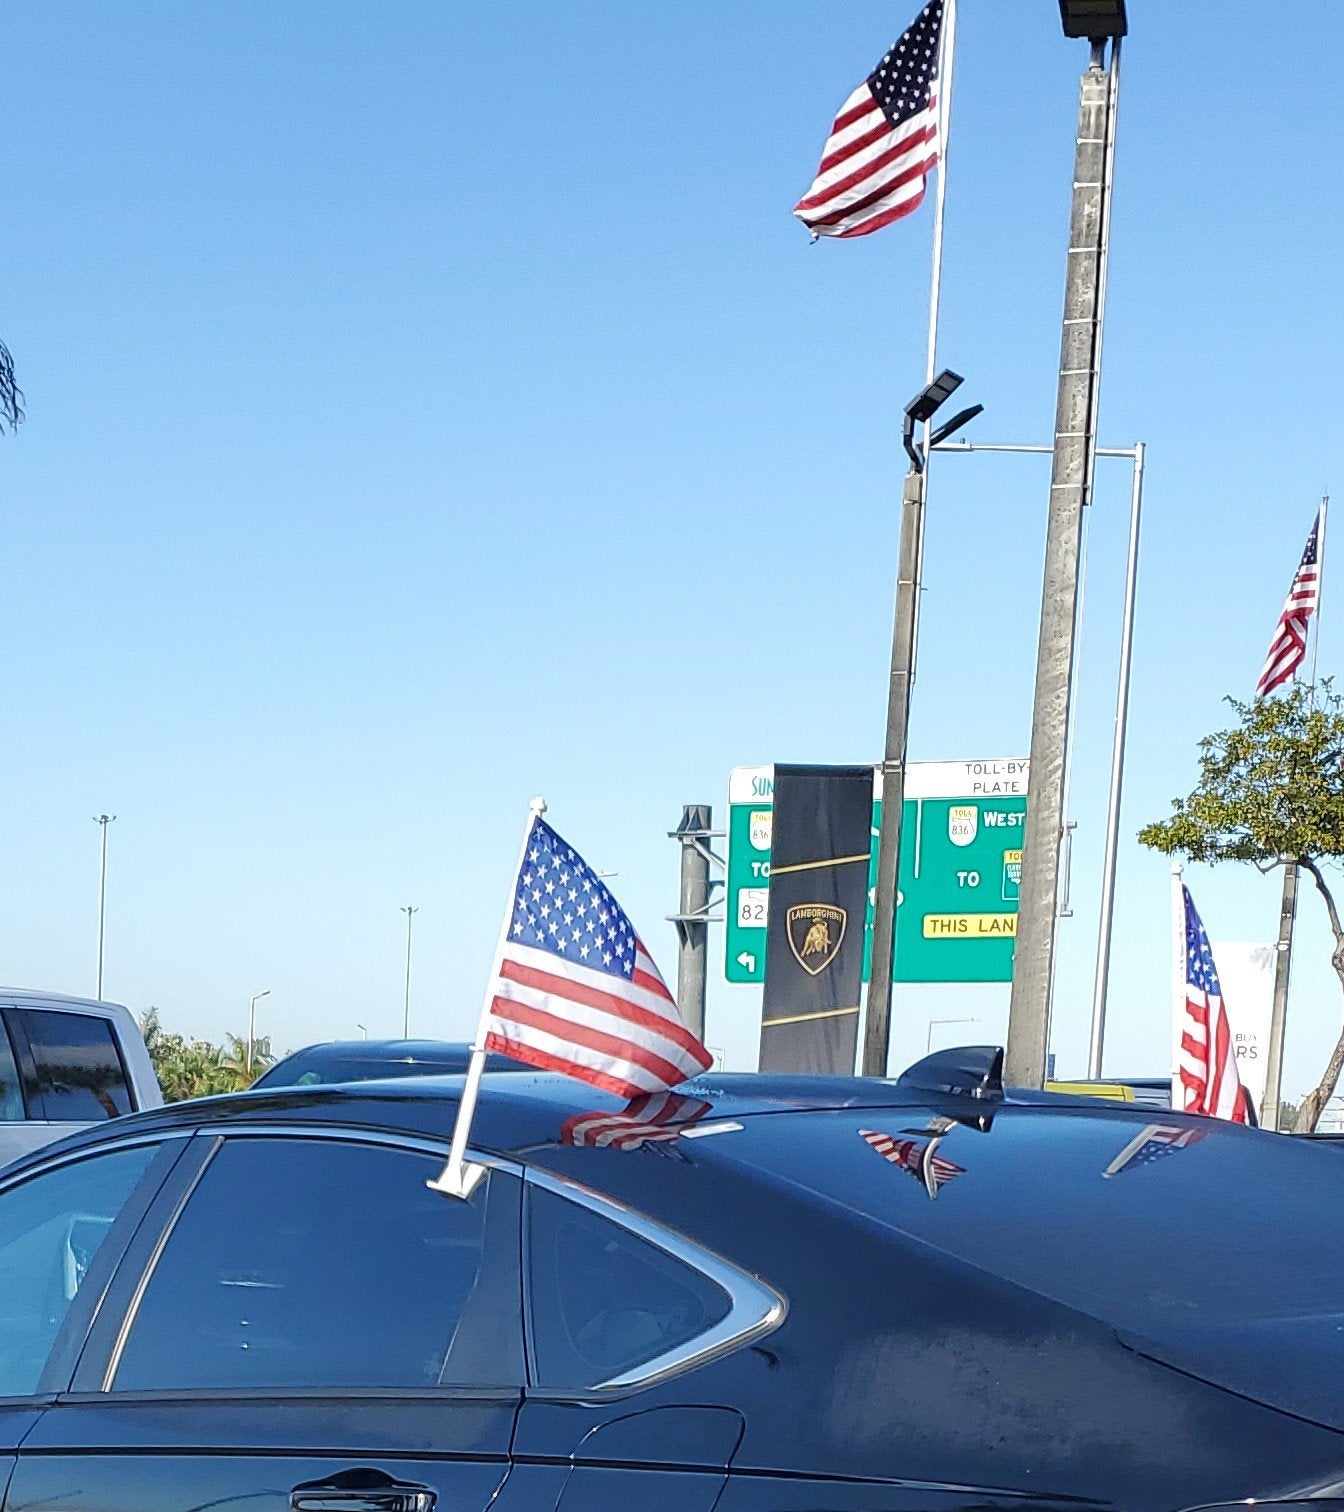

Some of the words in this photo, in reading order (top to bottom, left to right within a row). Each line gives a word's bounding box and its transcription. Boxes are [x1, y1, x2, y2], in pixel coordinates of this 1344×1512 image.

[752, 776, 774, 796] SUN
[973, 781, 1020, 793] PLATE
[955, 809, 972, 817] TOLL
[984, 811, 1026, 828] WEST
[952, 825, 969, 835] 836
[751, 862, 770, 877] TO
[957, 871, 980, 887] TO
[742, 905, 766, 920] 82
[930, 919, 968, 933] THIS
[979, 918, 1014, 932] LAN
[1236, 1046, 1258, 1059] RS
